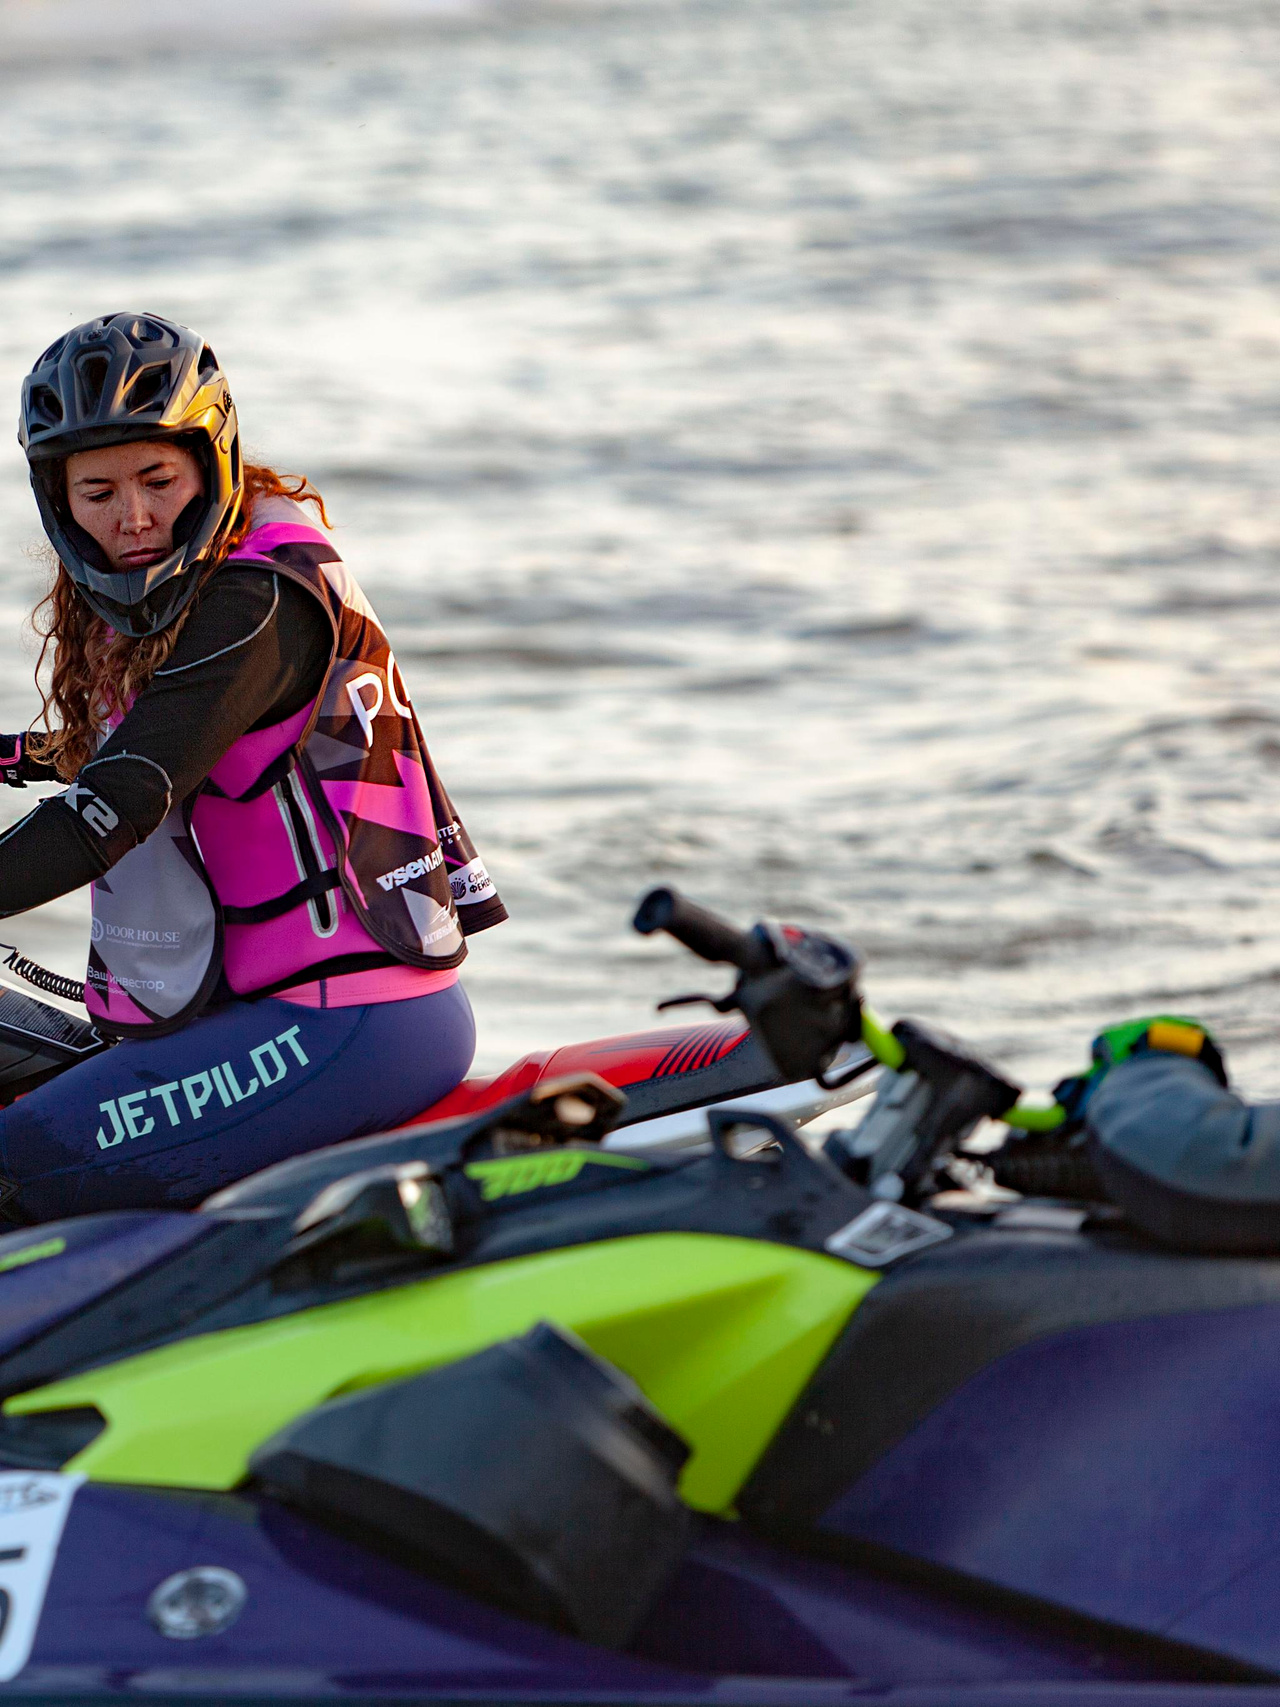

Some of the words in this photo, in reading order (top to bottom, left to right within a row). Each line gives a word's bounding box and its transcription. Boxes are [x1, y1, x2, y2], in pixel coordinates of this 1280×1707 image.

[55, 782, 119, 838] X2
[106, 924, 134, 940] DOOR
[137, 929, 180, 943] HOUSE
[87, 965, 108, 982] Ваш
[109, 974, 165, 993] инвестор
[96, 1024, 310, 1150] JETPILOT
